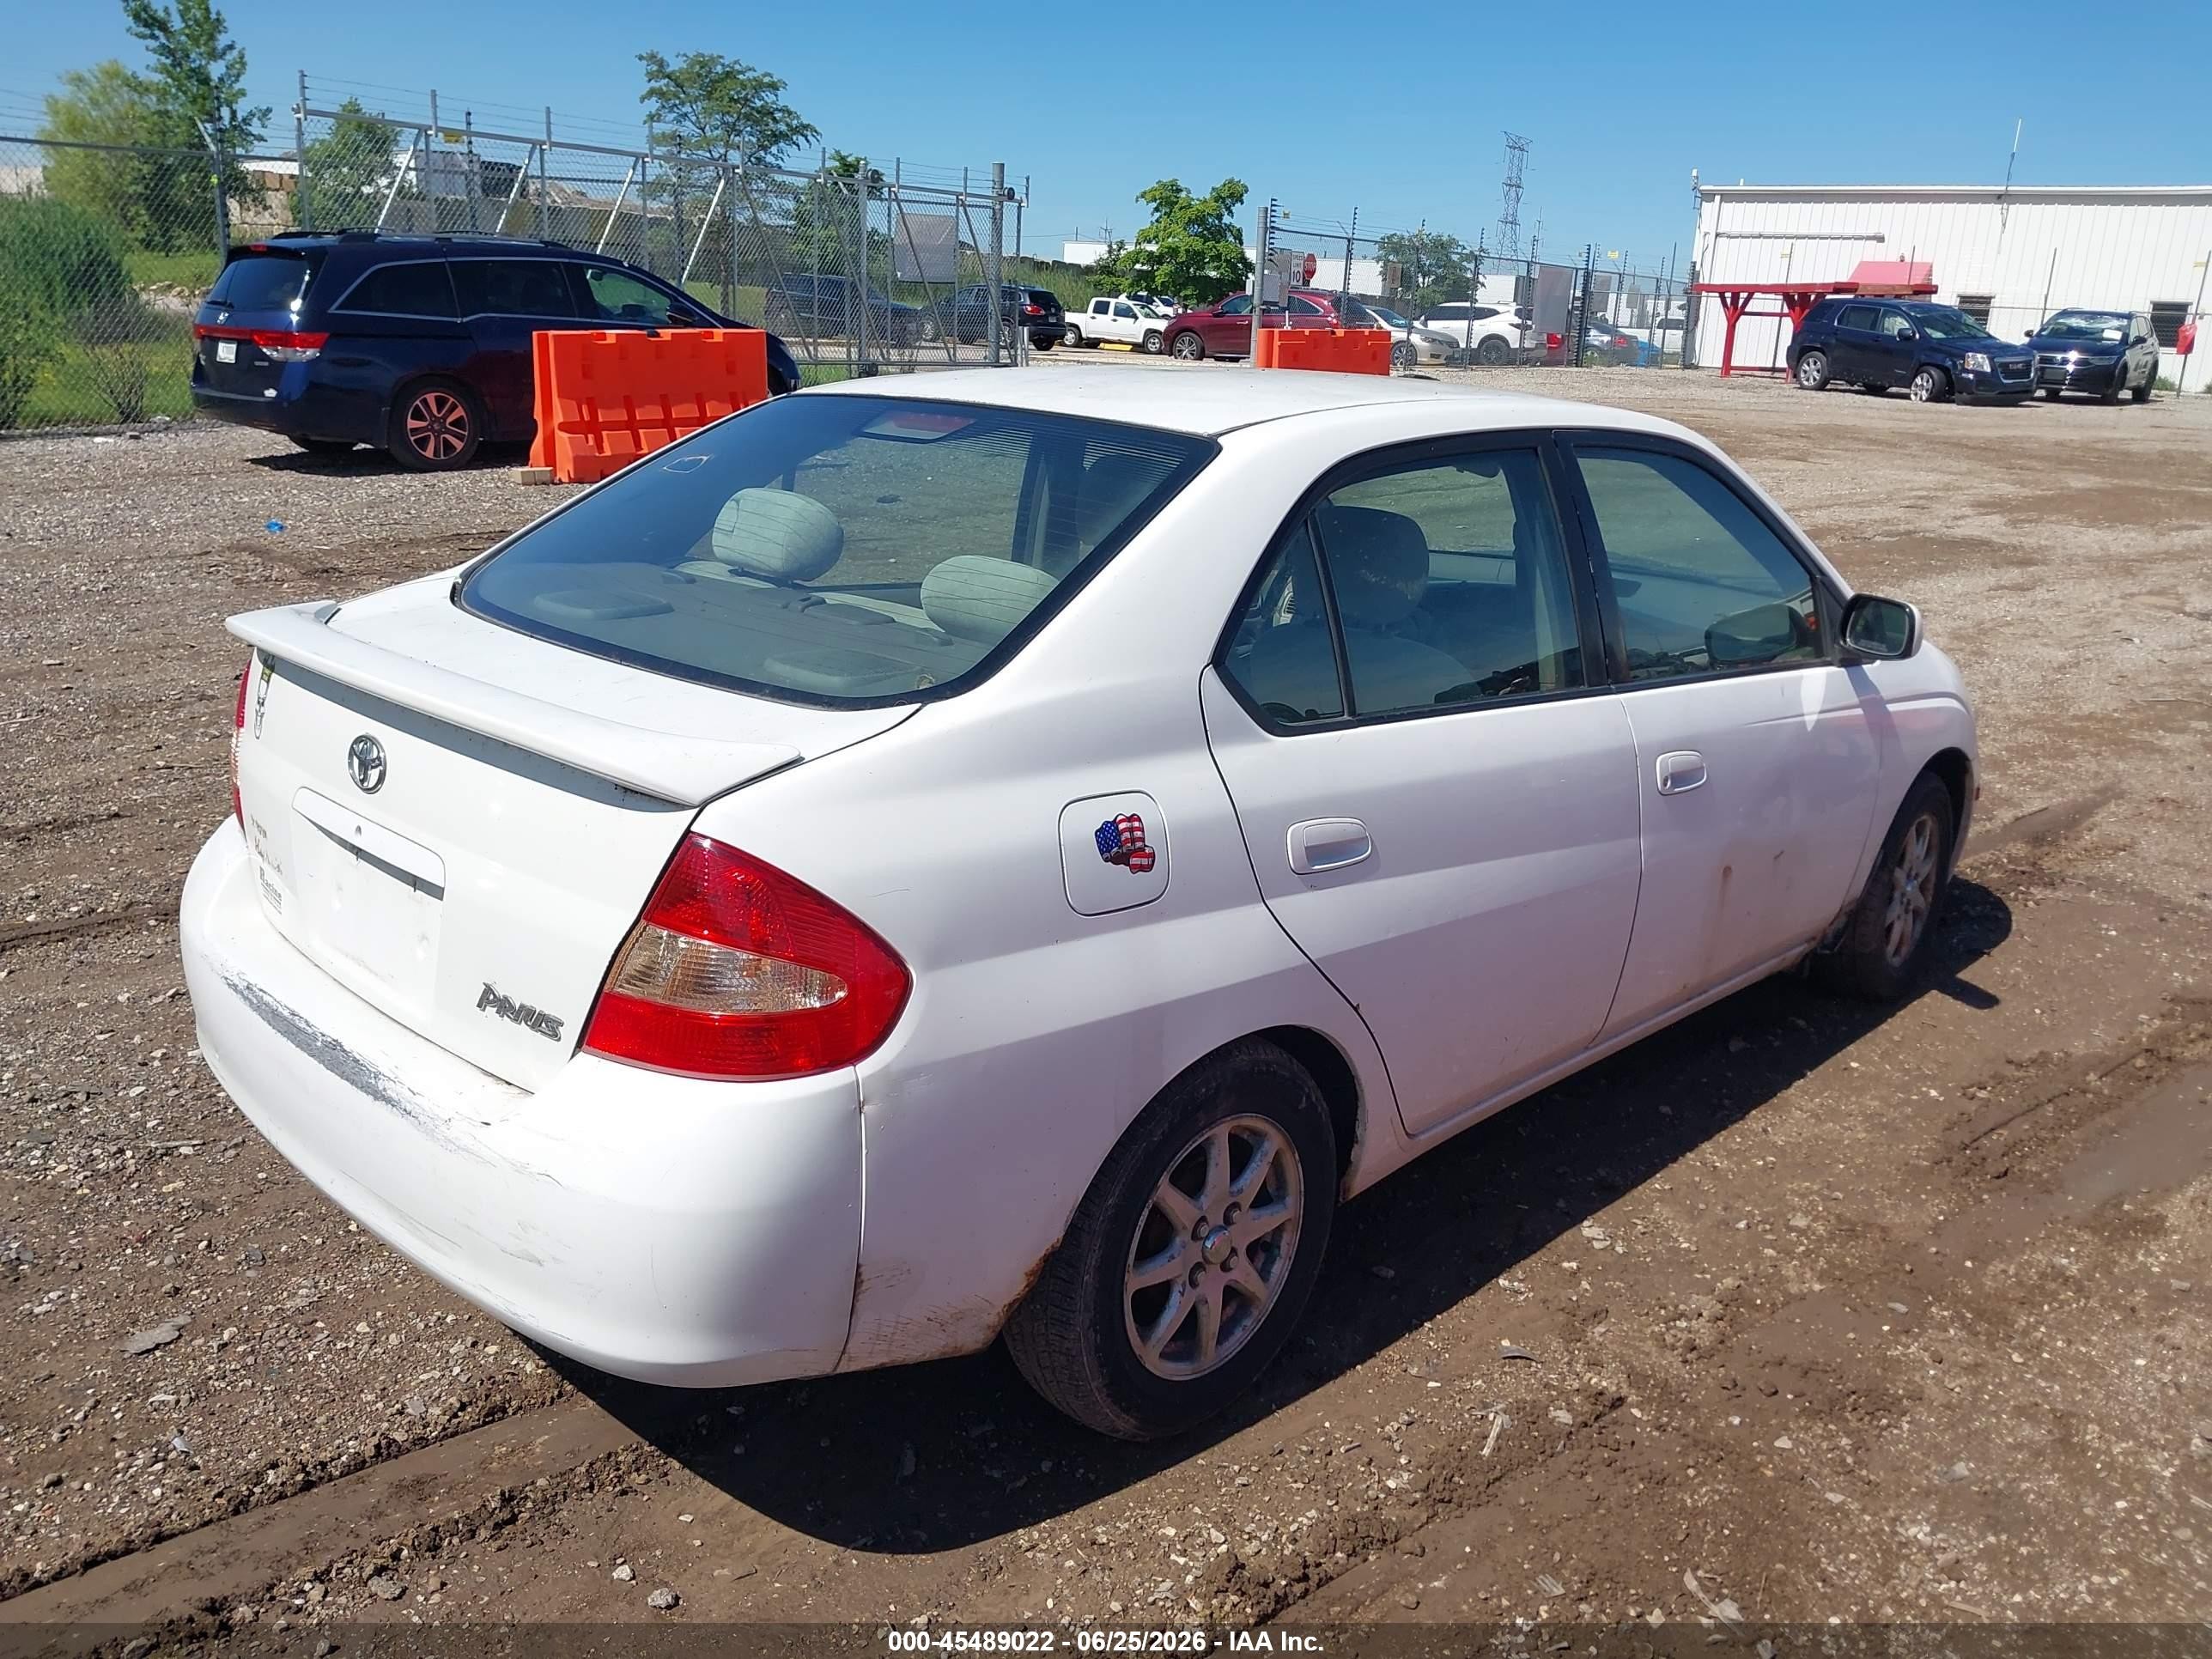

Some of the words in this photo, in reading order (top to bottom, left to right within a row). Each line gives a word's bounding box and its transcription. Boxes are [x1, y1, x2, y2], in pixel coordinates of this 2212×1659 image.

[1304, 261, 1316, 271] STOP
[1292, 270, 1301, 283] 10
[476, 981, 565, 1042] PRIUS
